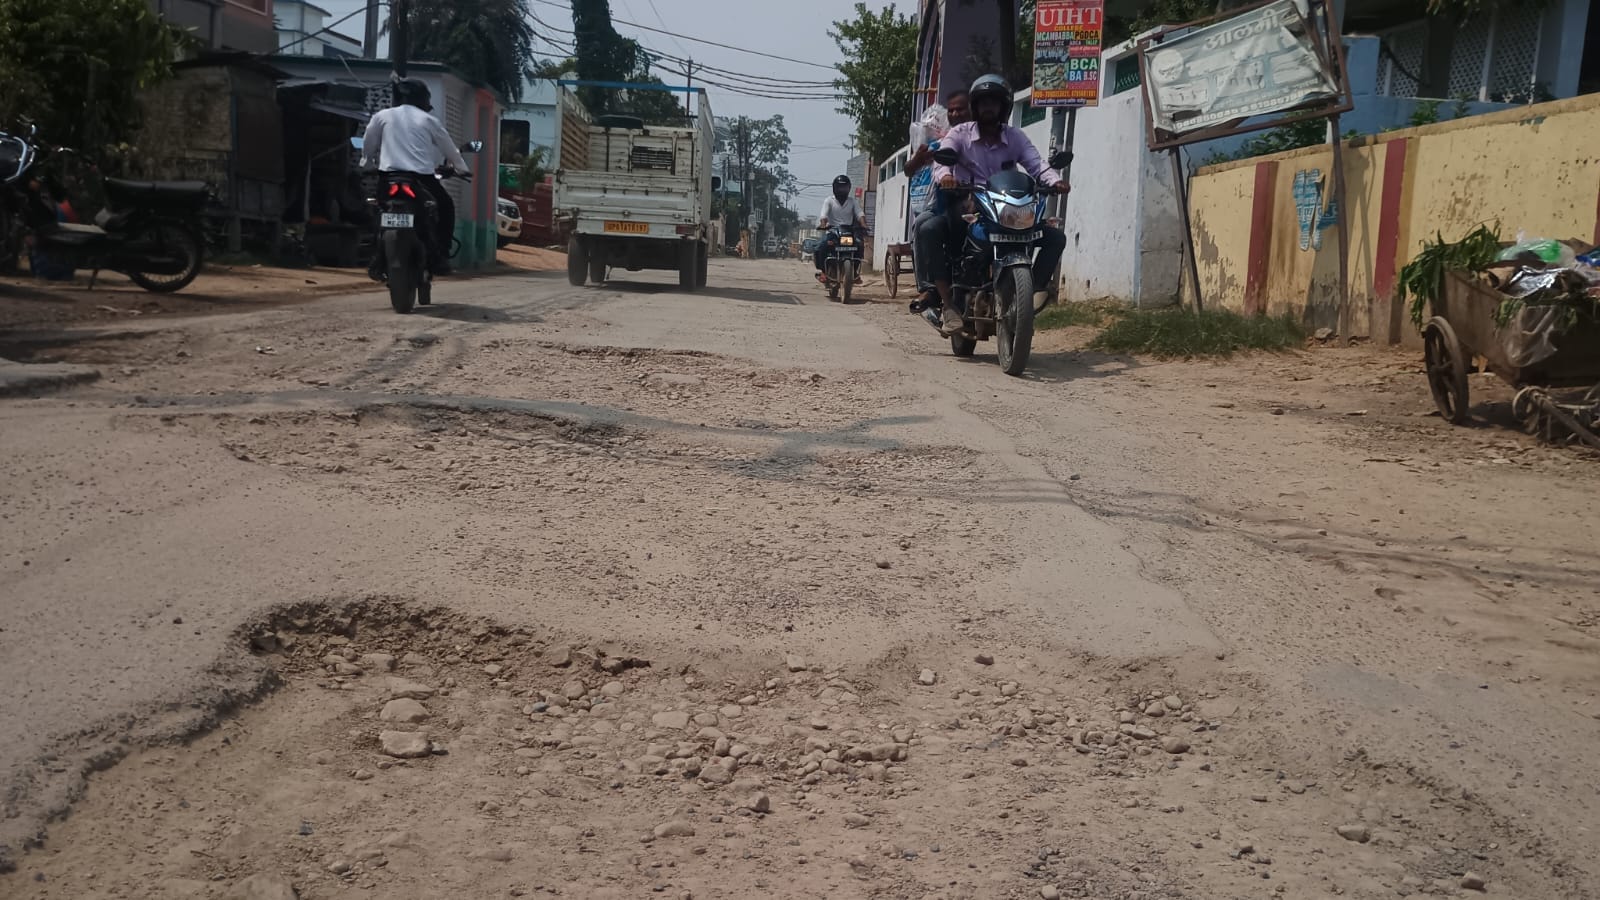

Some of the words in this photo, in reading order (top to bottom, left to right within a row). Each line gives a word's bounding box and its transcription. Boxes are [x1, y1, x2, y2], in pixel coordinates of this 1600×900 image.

[1038, 7, 1102, 26] UIHT
[1070, 58, 1098, 70] BCA
[1069, 71, 1082, 81] BA
